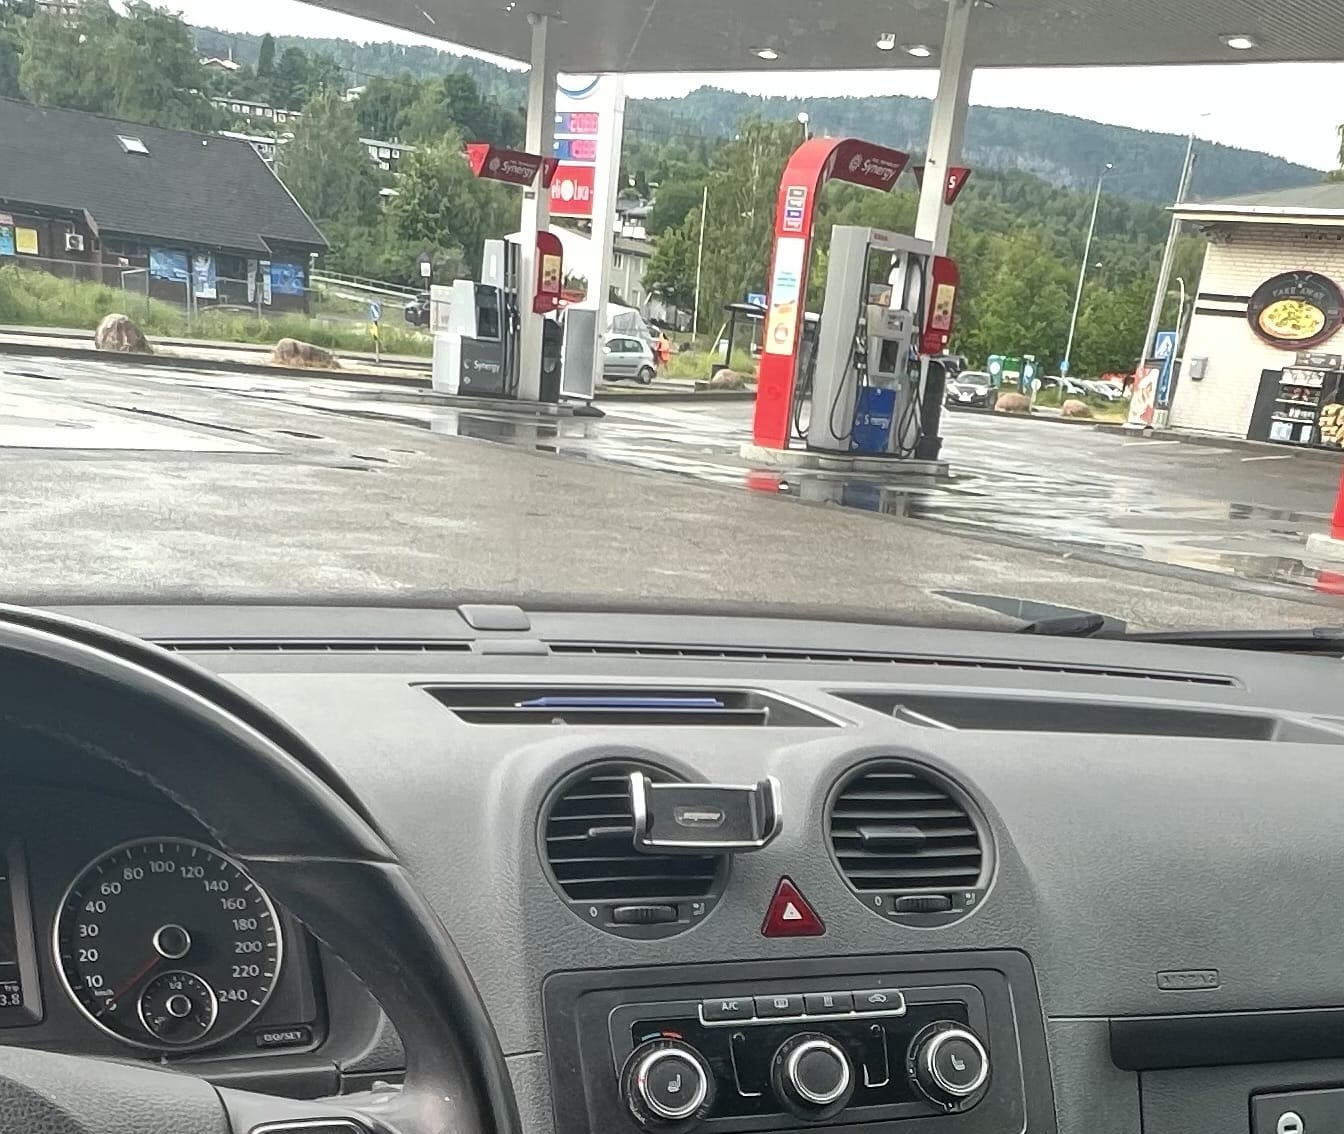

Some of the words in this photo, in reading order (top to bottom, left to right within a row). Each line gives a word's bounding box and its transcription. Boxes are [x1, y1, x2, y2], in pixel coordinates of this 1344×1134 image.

[500, 160, 534, 178] Synergy
[861, 159, 896, 181] Synergy
[1272, 286, 1297, 297] TAKE
[1299, 286, 1327, 300] AWAY
[148, 860, 176, 873] 100
[180, 866, 204, 879] 120
[123, 867, 144, 880] 80
[100, 882, 122, 895] 60
[203, 880, 229, 892] 140
[85, 900, 106, 913] 40
[221, 898, 247, 910] 160
[79, 924, 99, 937] 30
[232, 918, 257, 931] 180
[234, 940, 263, 953] 200
[79, 949, 99, 962] 20
[232, 965, 260, 978] 220
[86, 974, 104, 988] 10
[218, 989, 248, 1001] 240
[721, 1001, 739, 1012] A/C
